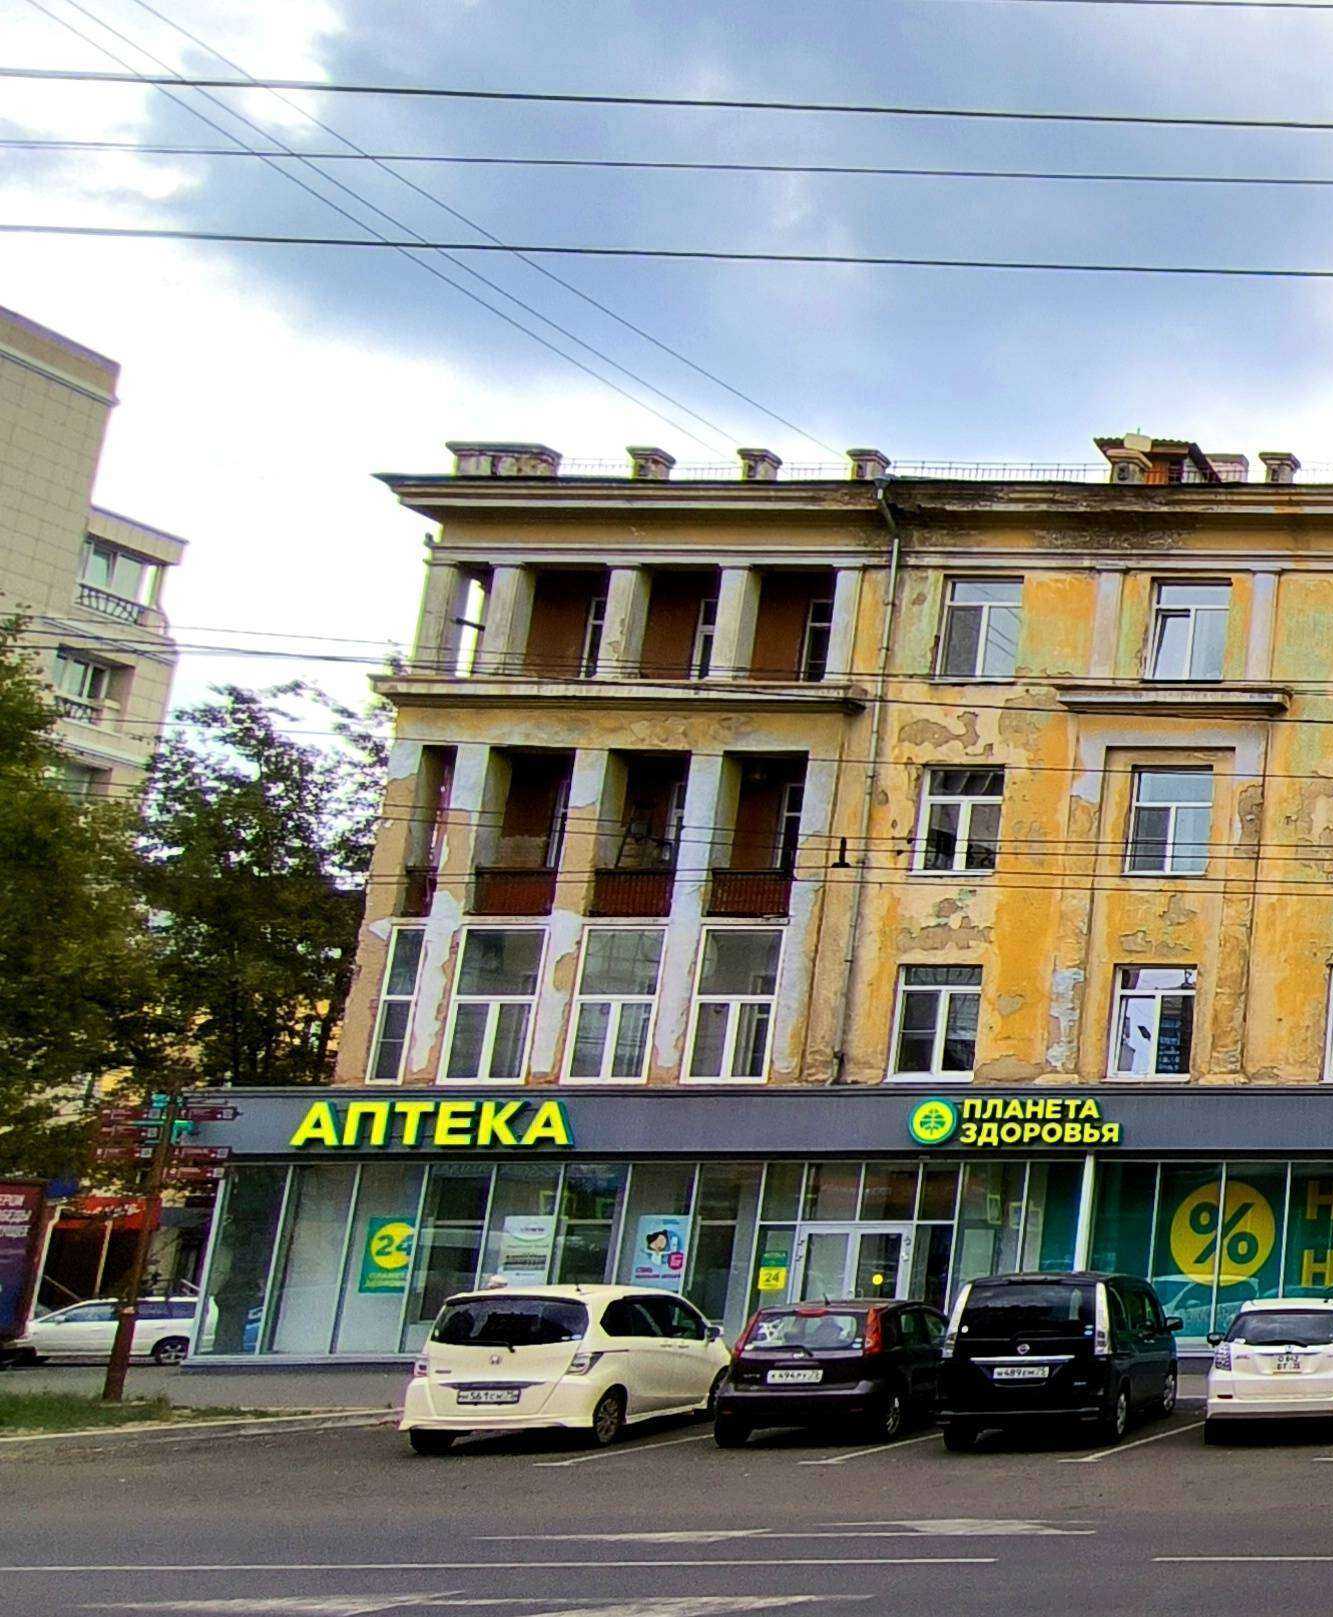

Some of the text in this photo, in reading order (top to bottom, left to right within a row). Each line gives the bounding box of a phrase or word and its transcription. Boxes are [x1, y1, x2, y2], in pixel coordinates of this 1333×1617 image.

[962, 1098, 1100, 1120] ПЛАНЕТА
[289, 1100, 574, 1147] АПТЕКА
[960, 1122, 1120, 1147] ЗДОРОВЬЯ
[764, 1271, 780, 1284] 24
